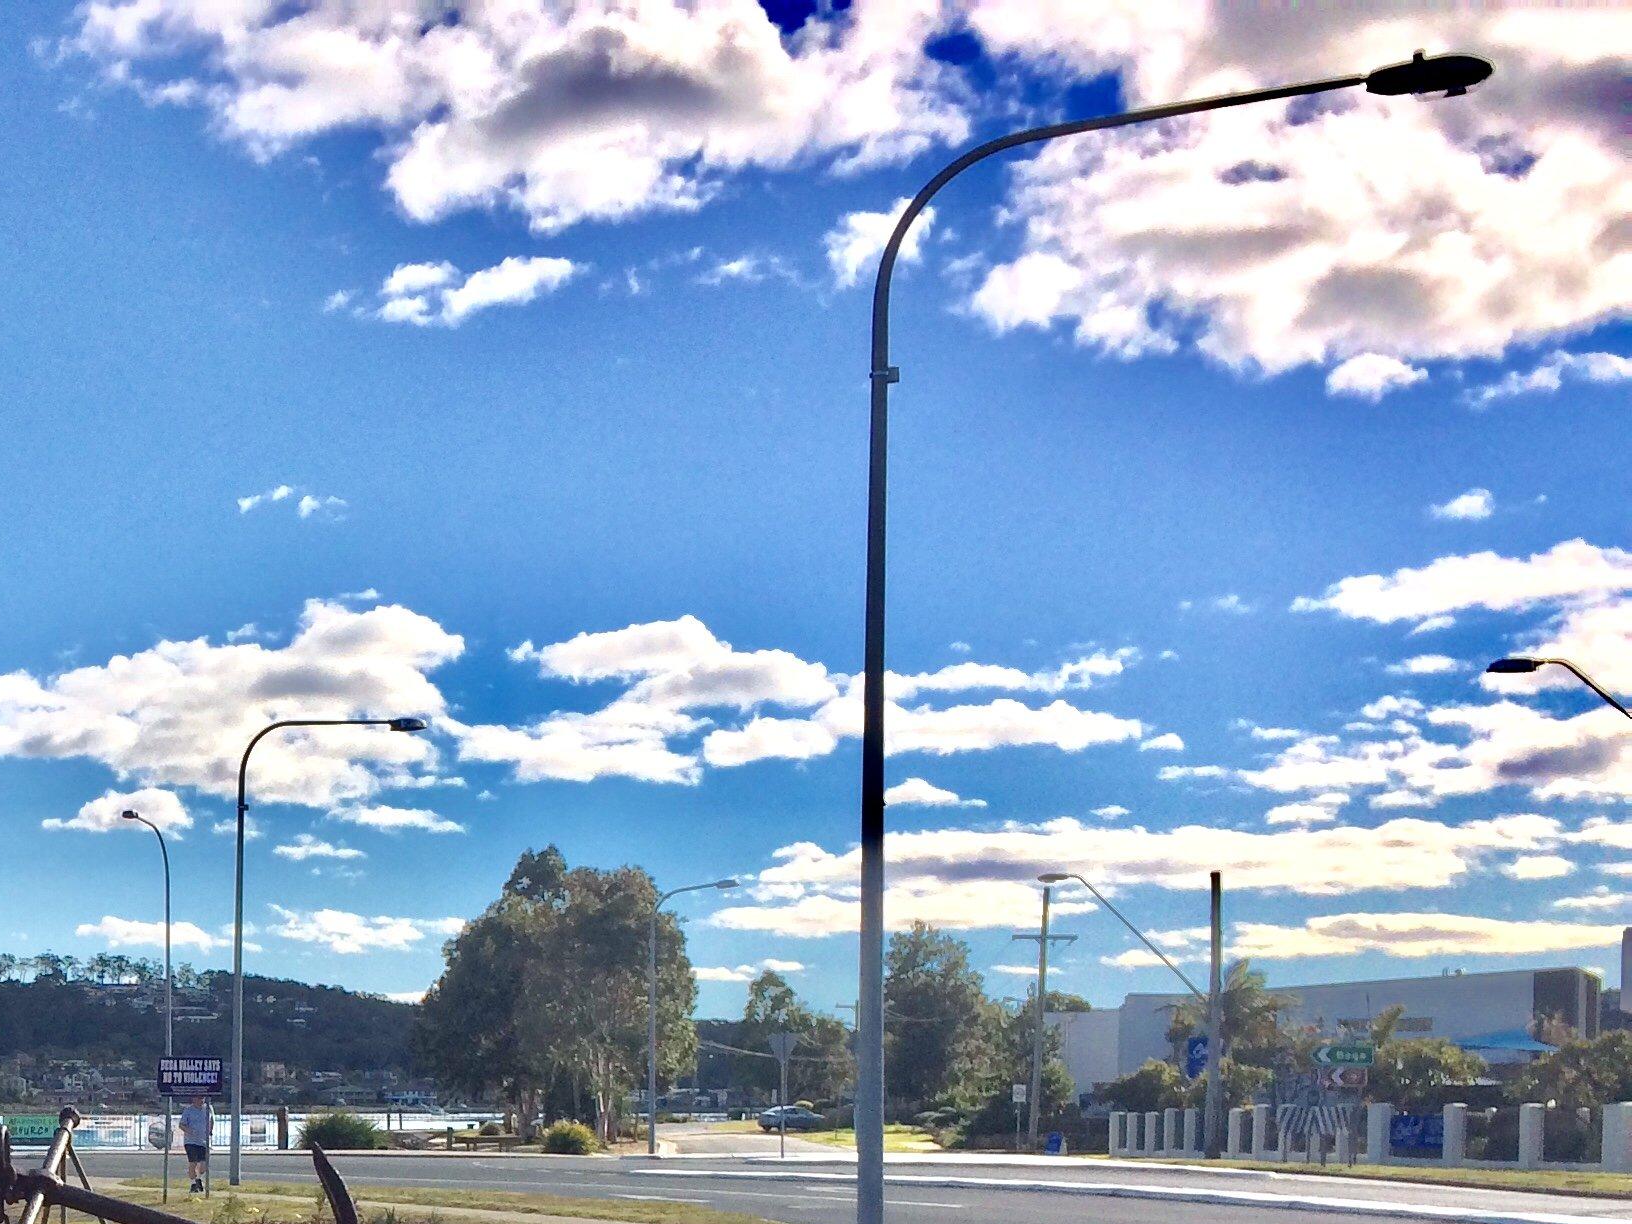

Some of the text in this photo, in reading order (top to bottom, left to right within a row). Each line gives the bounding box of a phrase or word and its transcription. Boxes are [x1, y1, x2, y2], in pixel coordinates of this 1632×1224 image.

[178, 1059, 203, 1071] VALLEY
[162, 1071, 173, 1084] NO
[173, 1071, 183, 1084] TO
